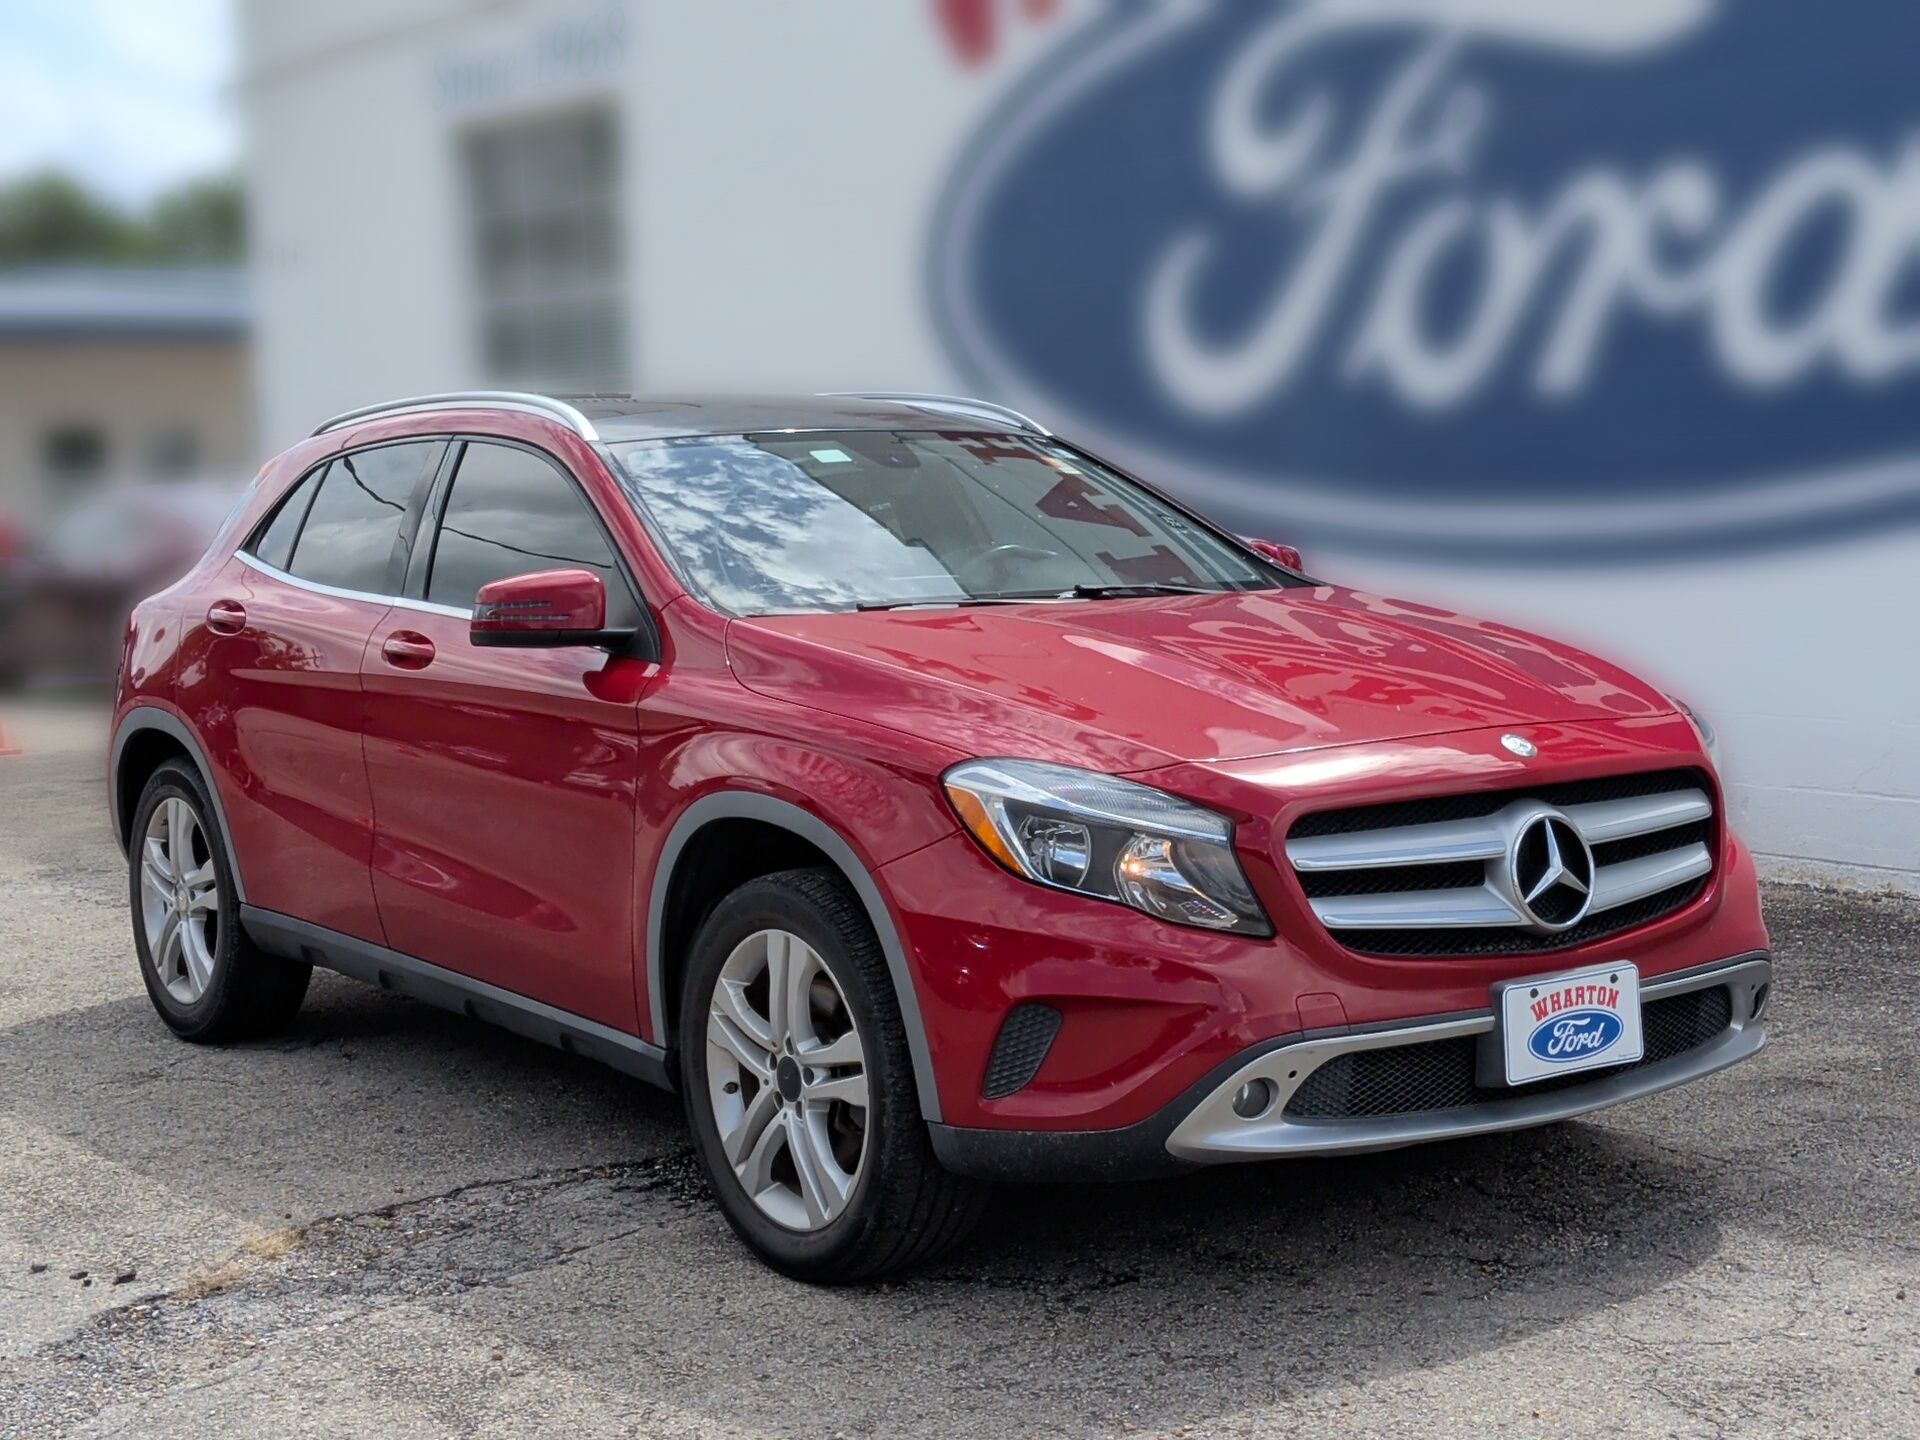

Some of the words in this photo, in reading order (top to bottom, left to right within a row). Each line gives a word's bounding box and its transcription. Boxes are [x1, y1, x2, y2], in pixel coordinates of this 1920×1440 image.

[533, 5, 625, 88] 1968
[1530, 985, 1619, 1022] WHARTON
[1547, 1017, 1605, 1055] Ford
